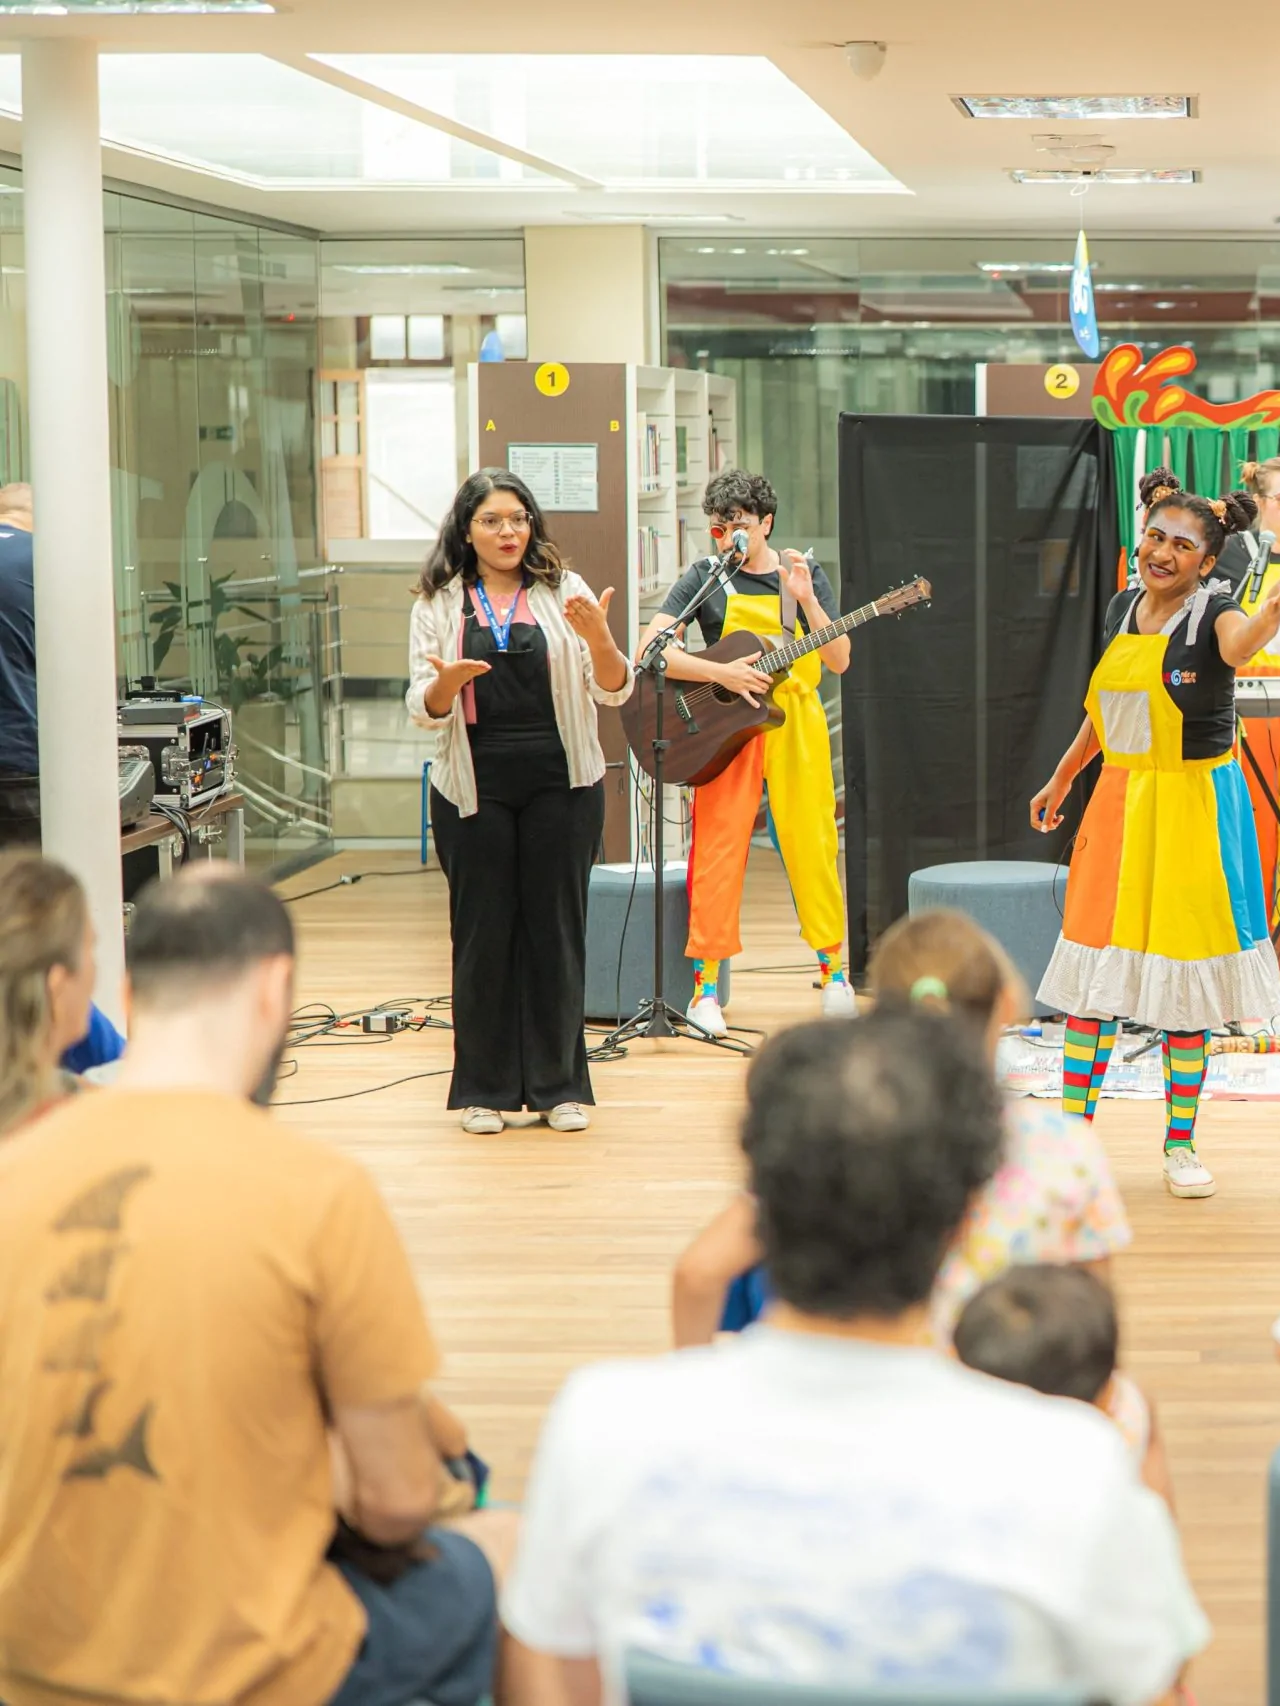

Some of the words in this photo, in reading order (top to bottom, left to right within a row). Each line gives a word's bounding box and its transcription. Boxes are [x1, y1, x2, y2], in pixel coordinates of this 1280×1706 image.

[547, 372, 555, 387] 1
[1055, 373, 1068, 389] 2
[485, 419, 496, 431] A
[610, 420, 620, 432] B
